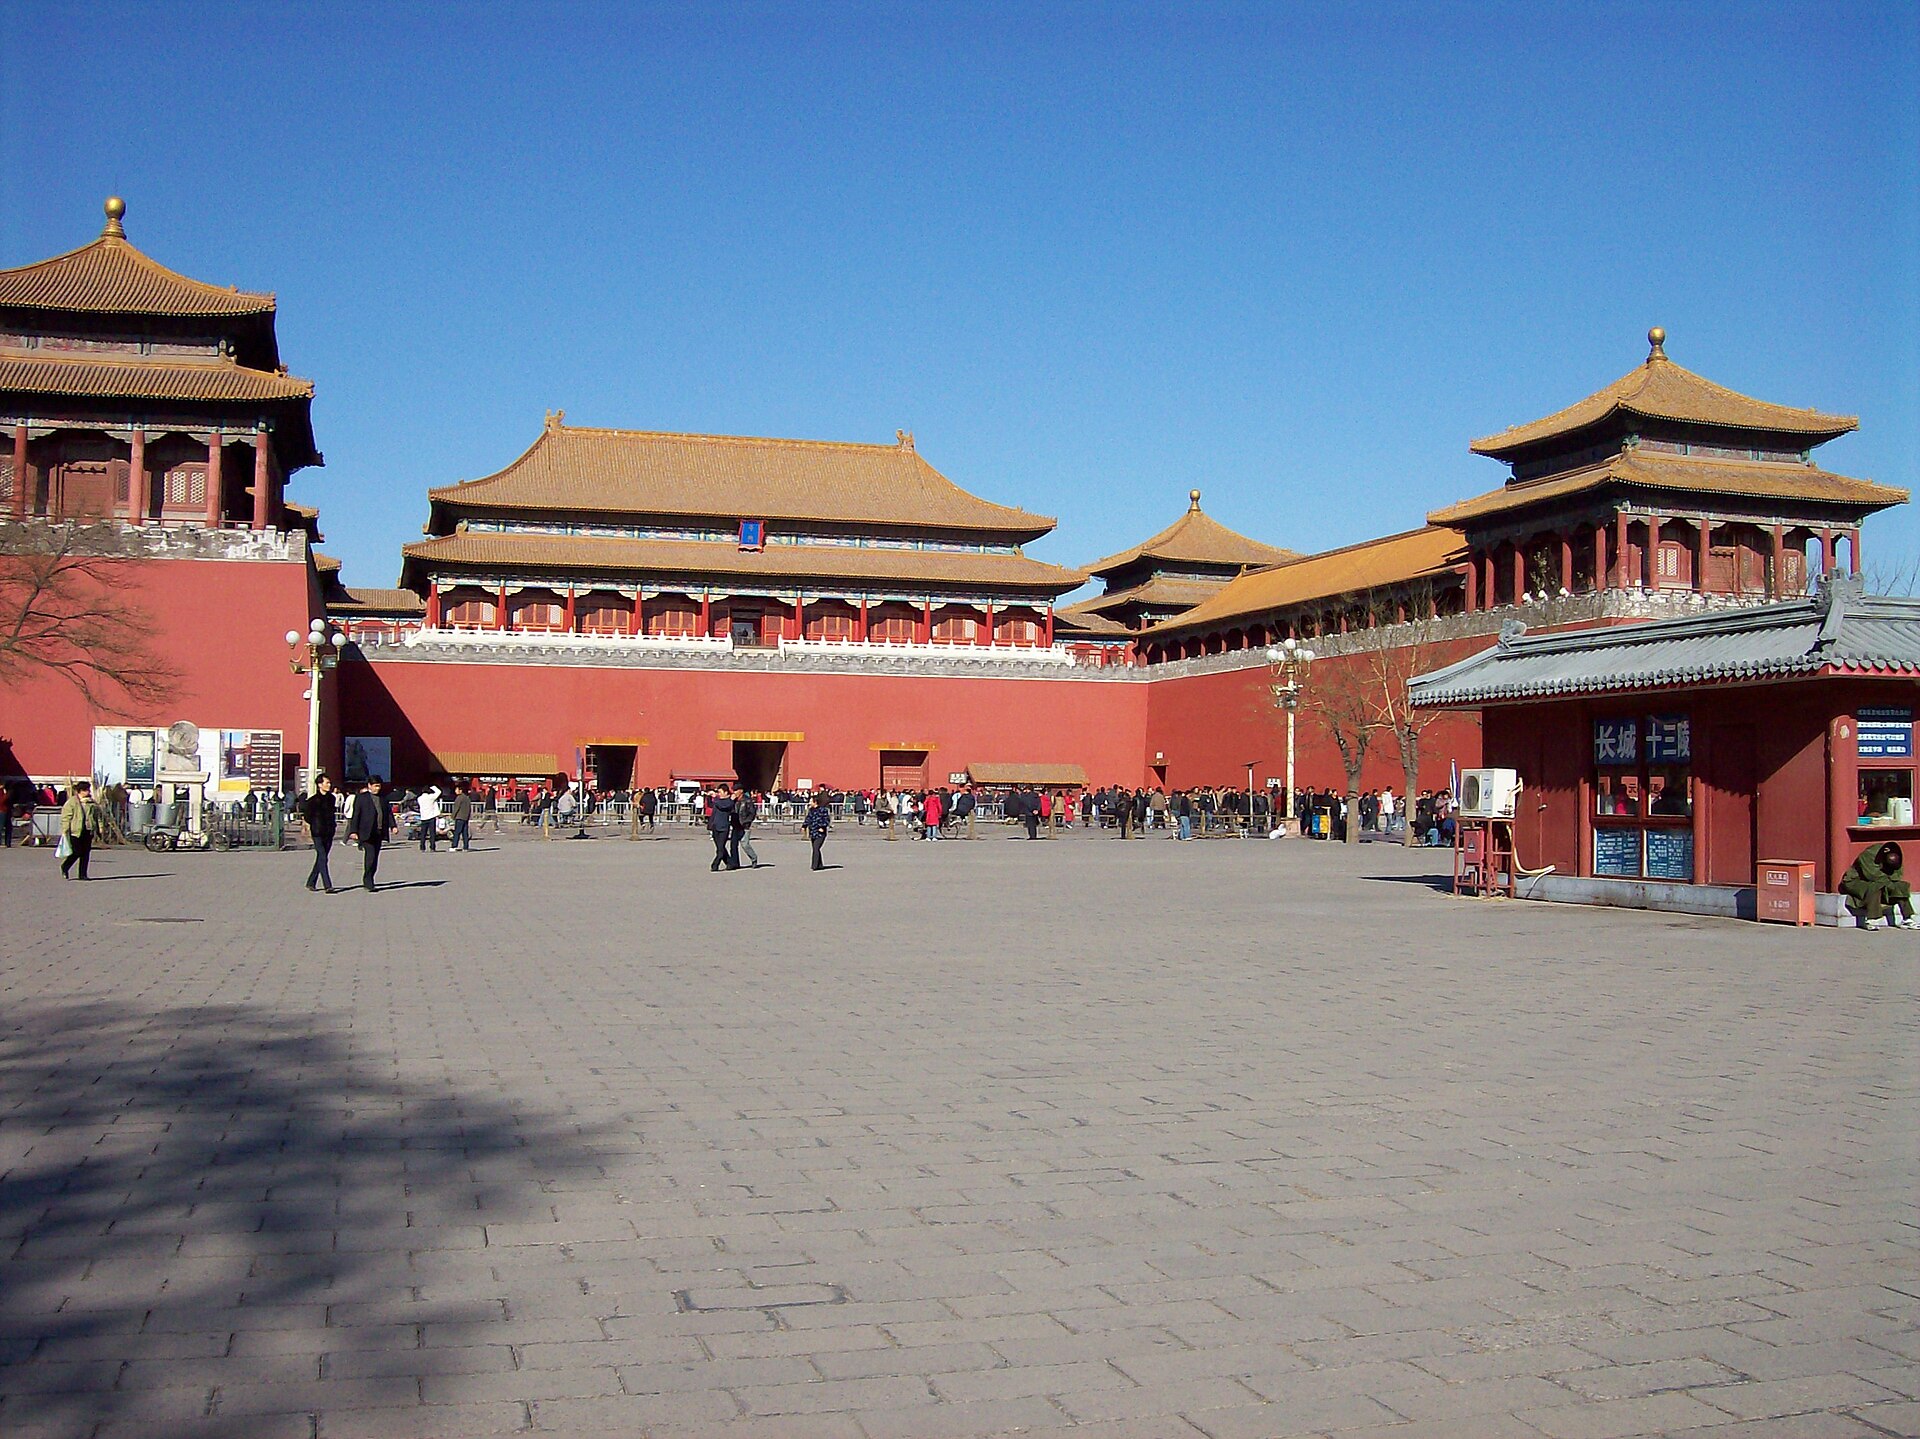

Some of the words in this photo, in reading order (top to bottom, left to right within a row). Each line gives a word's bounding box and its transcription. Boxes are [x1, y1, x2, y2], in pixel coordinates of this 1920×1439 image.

[1595, 724, 1636, 759] 长城
[1646, 720, 1690, 758] 十三陵
